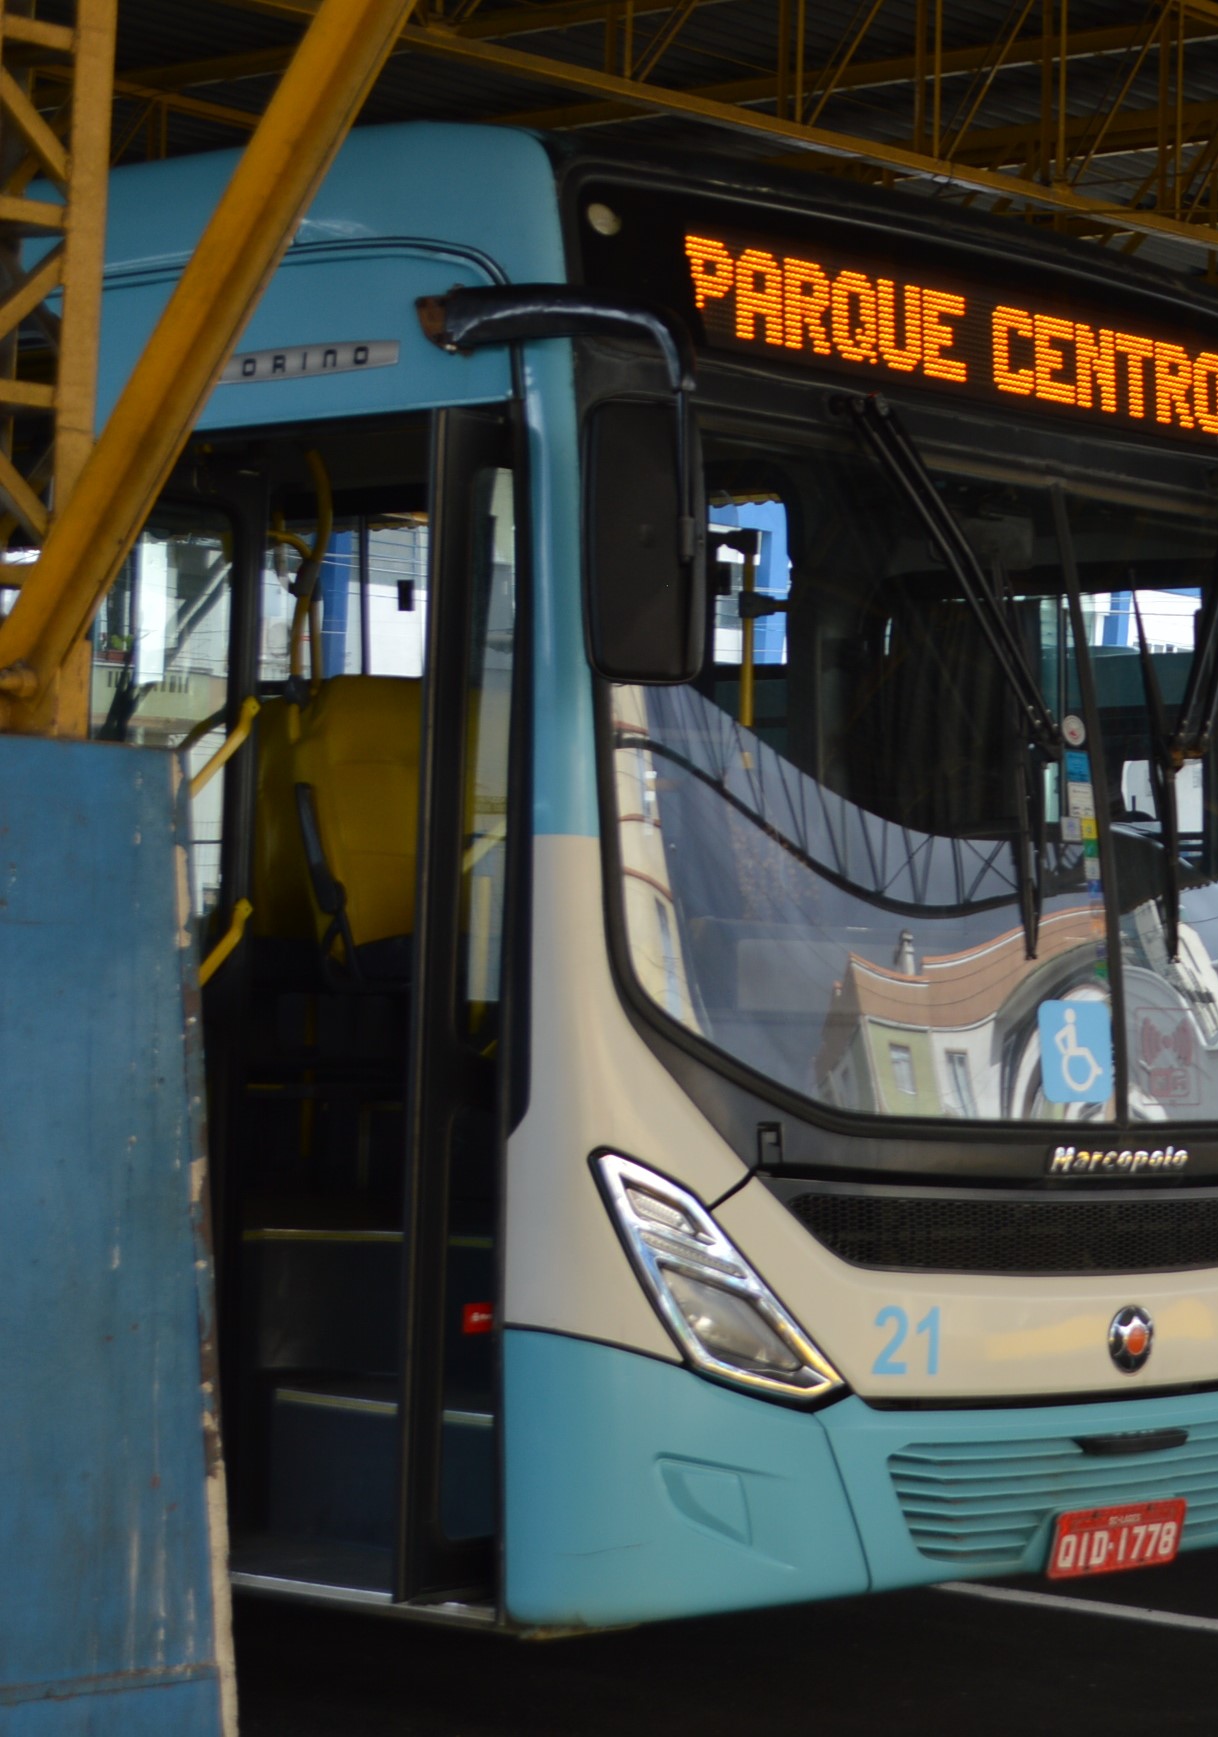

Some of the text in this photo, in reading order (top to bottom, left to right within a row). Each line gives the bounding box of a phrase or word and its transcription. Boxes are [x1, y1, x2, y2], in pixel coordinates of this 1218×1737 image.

[685, 235, 967, 382] PARQUE
[242, 346, 369, 377] ORINO
[1050, 1145, 1189, 1173] Marcopolo
[871, 1305, 940, 1374] 21
